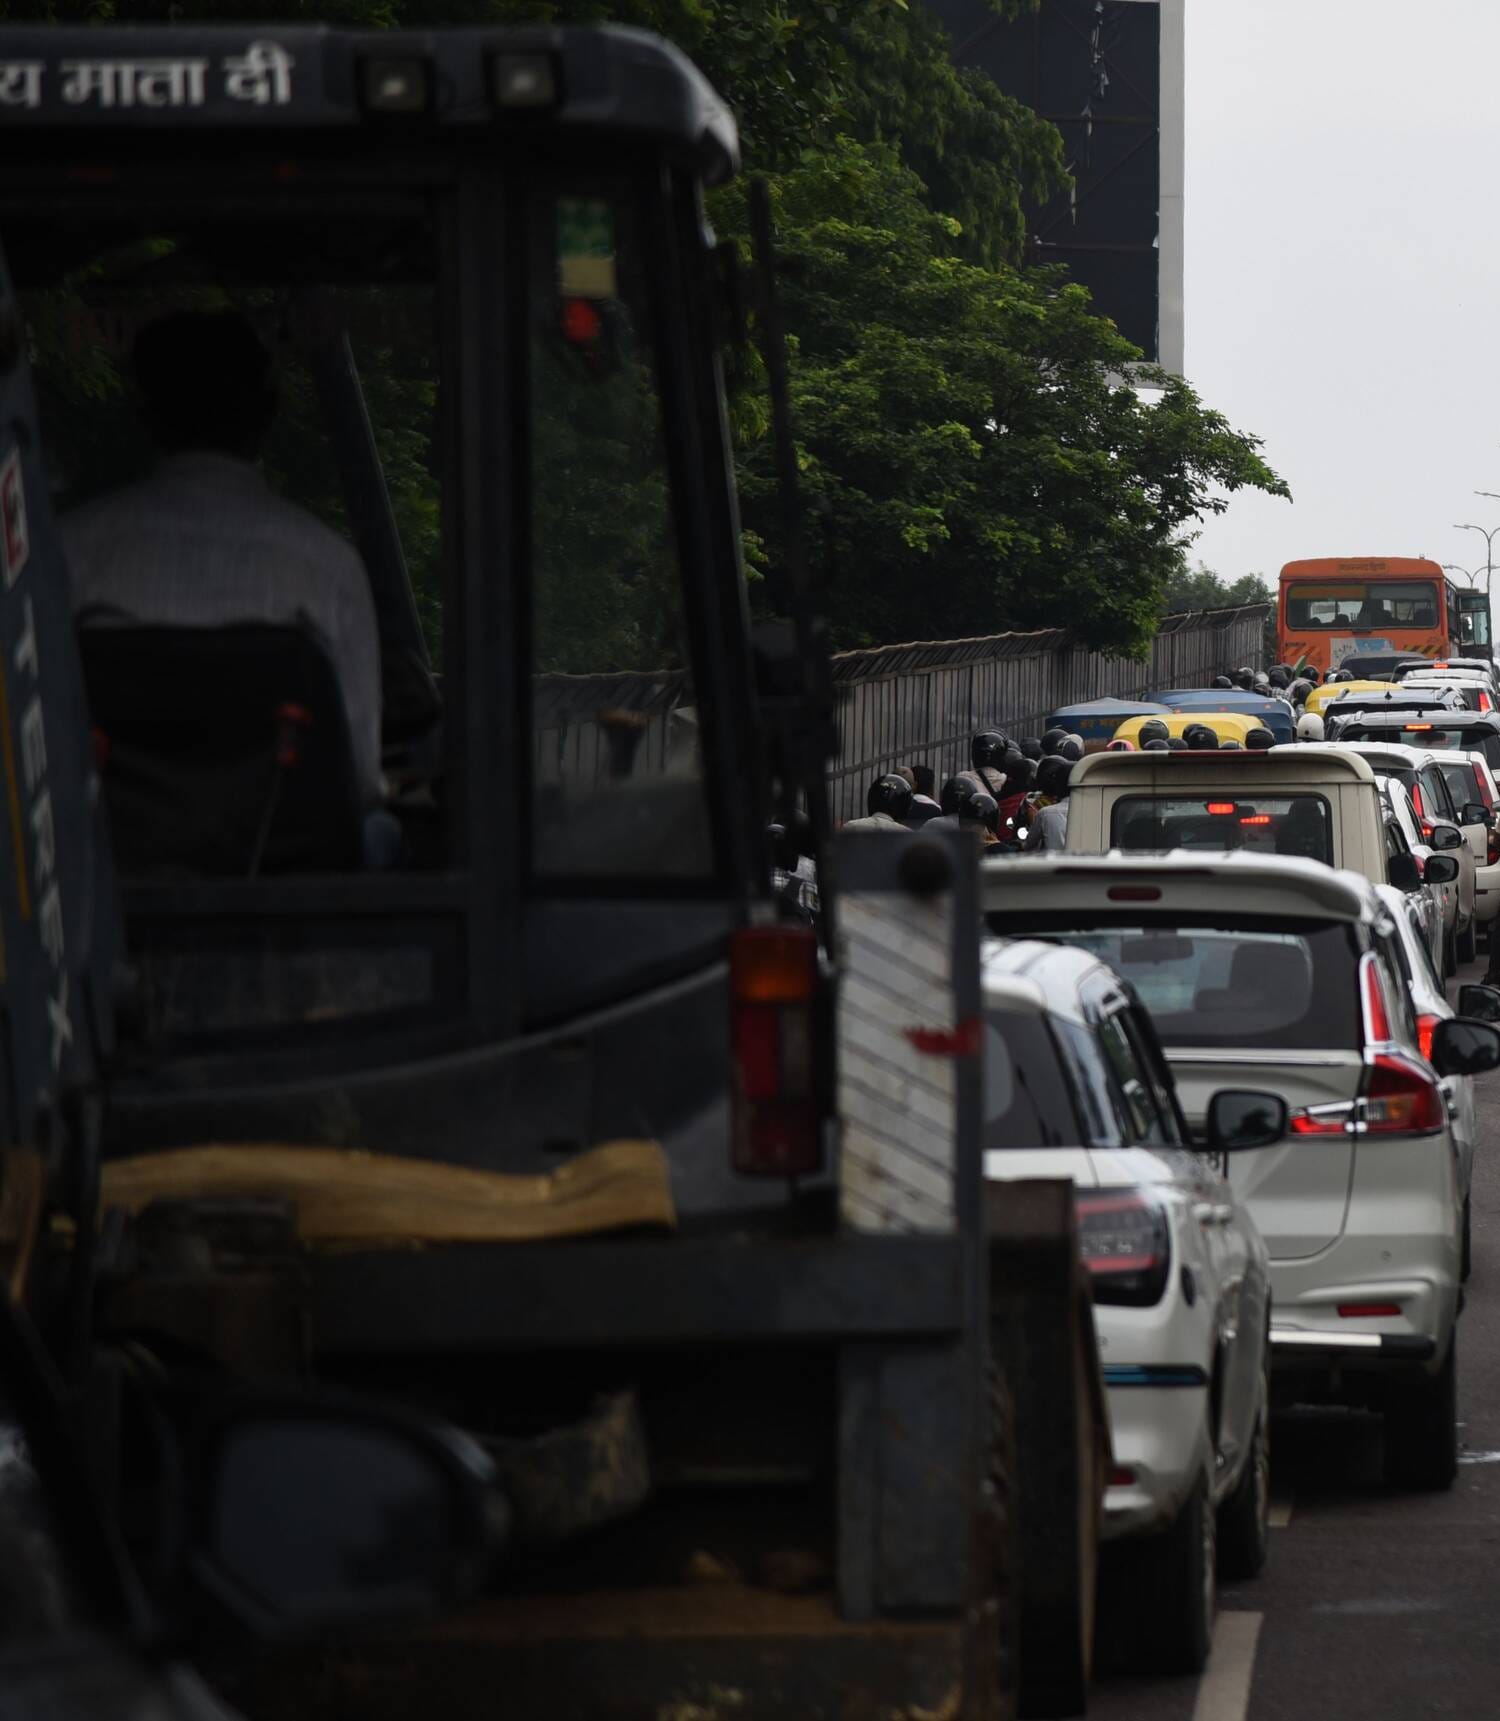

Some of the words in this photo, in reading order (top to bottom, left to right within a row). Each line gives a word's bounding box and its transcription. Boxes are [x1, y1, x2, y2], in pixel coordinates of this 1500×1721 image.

[0, 58, 46, 108] य
[59, 56, 208, 106] माता
[222, 40, 296, 106] दी
